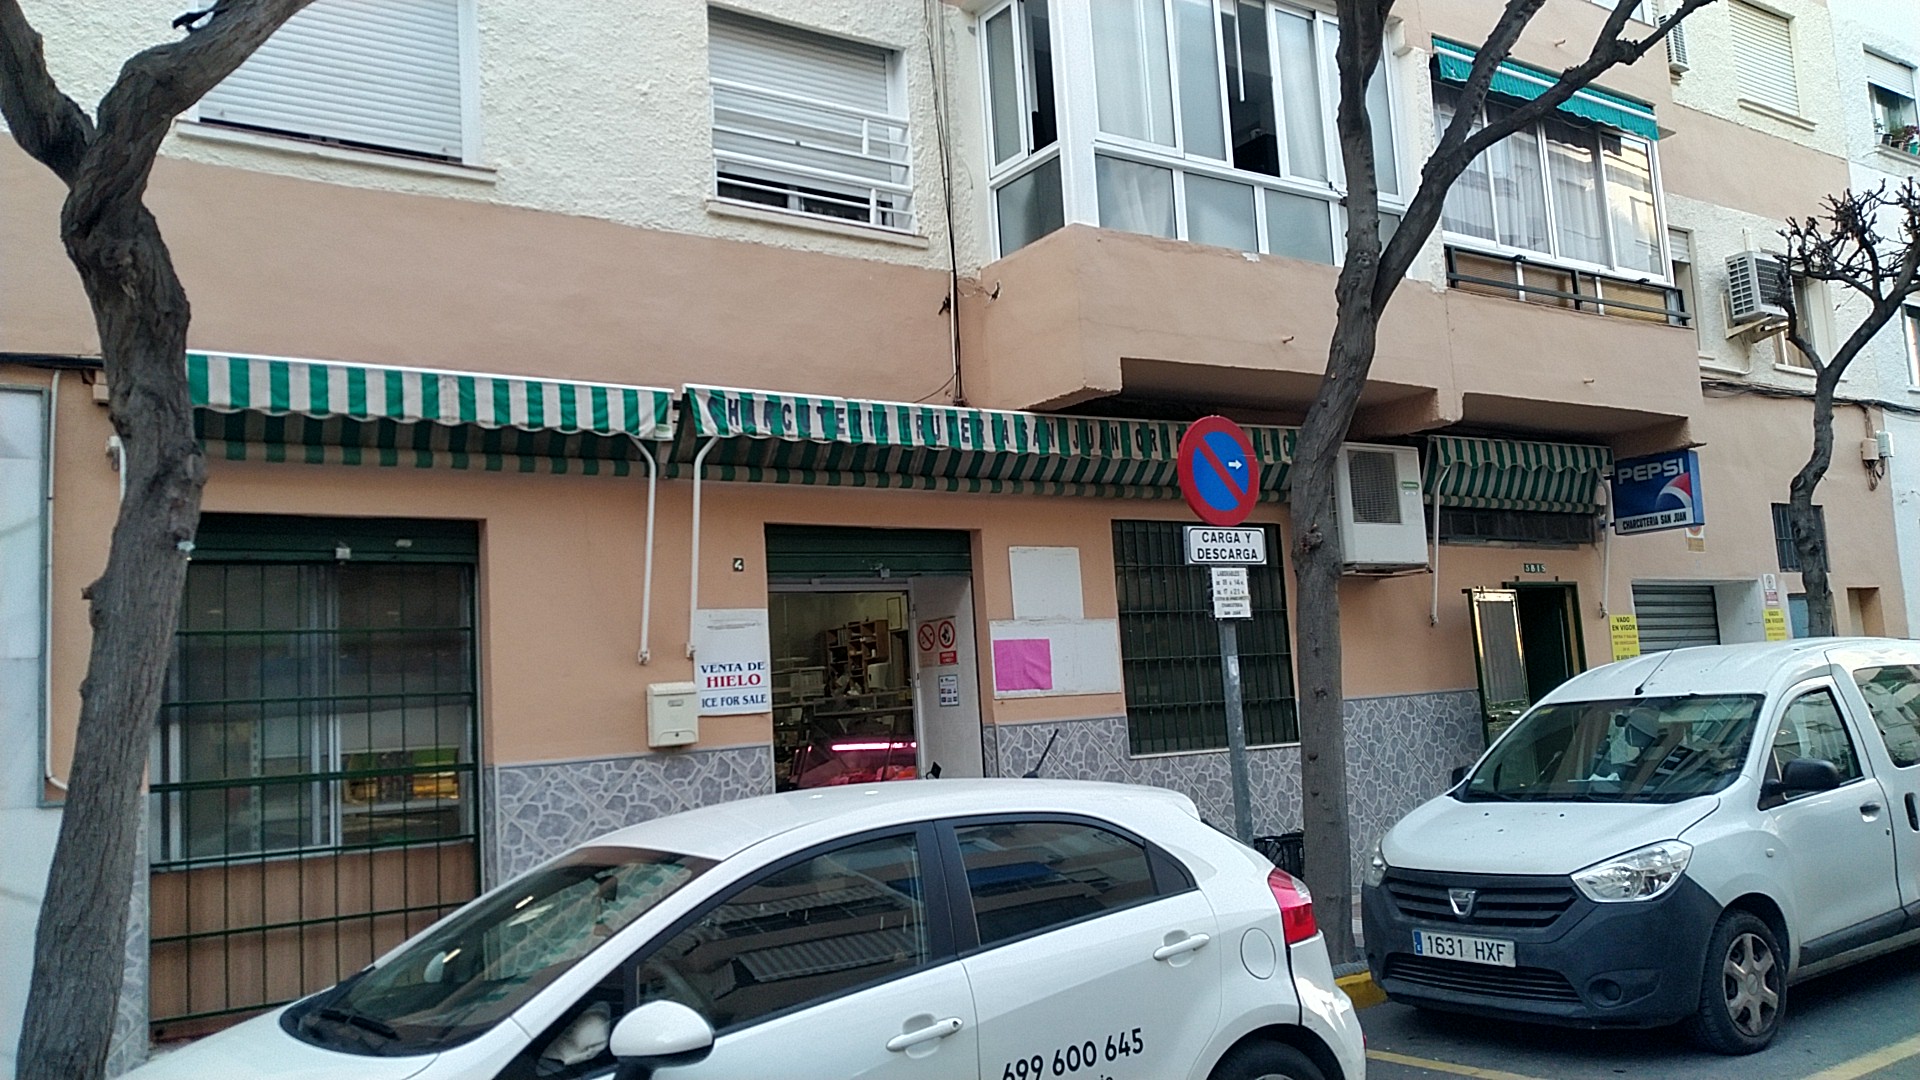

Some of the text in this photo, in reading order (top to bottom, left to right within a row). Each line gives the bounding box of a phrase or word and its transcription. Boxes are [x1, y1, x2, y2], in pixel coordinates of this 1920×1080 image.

[707, 397, 890, 436] CHARCUTERIA
[1020, 420, 1056, 448] SAN
[1072, 425, 1119, 451] JUAN
[1618, 457, 1684, 485] PEPSI
[1622, 511, 1687, 530] CHARCUTERIA SAN JUAN
[1201, 531, 1251, 543] CARGA Y
[1197, 548, 1258, 560] DESCARGA
[700, 661, 766, 674] VENTA DE
[706, 673, 761, 688] HIELO
[702, 693, 767, 708] ICE FOR SALE
[1427, 935, 1506, 962] 1631 HXF
[1002, 1027, 1144, 1080] 699 600 645
